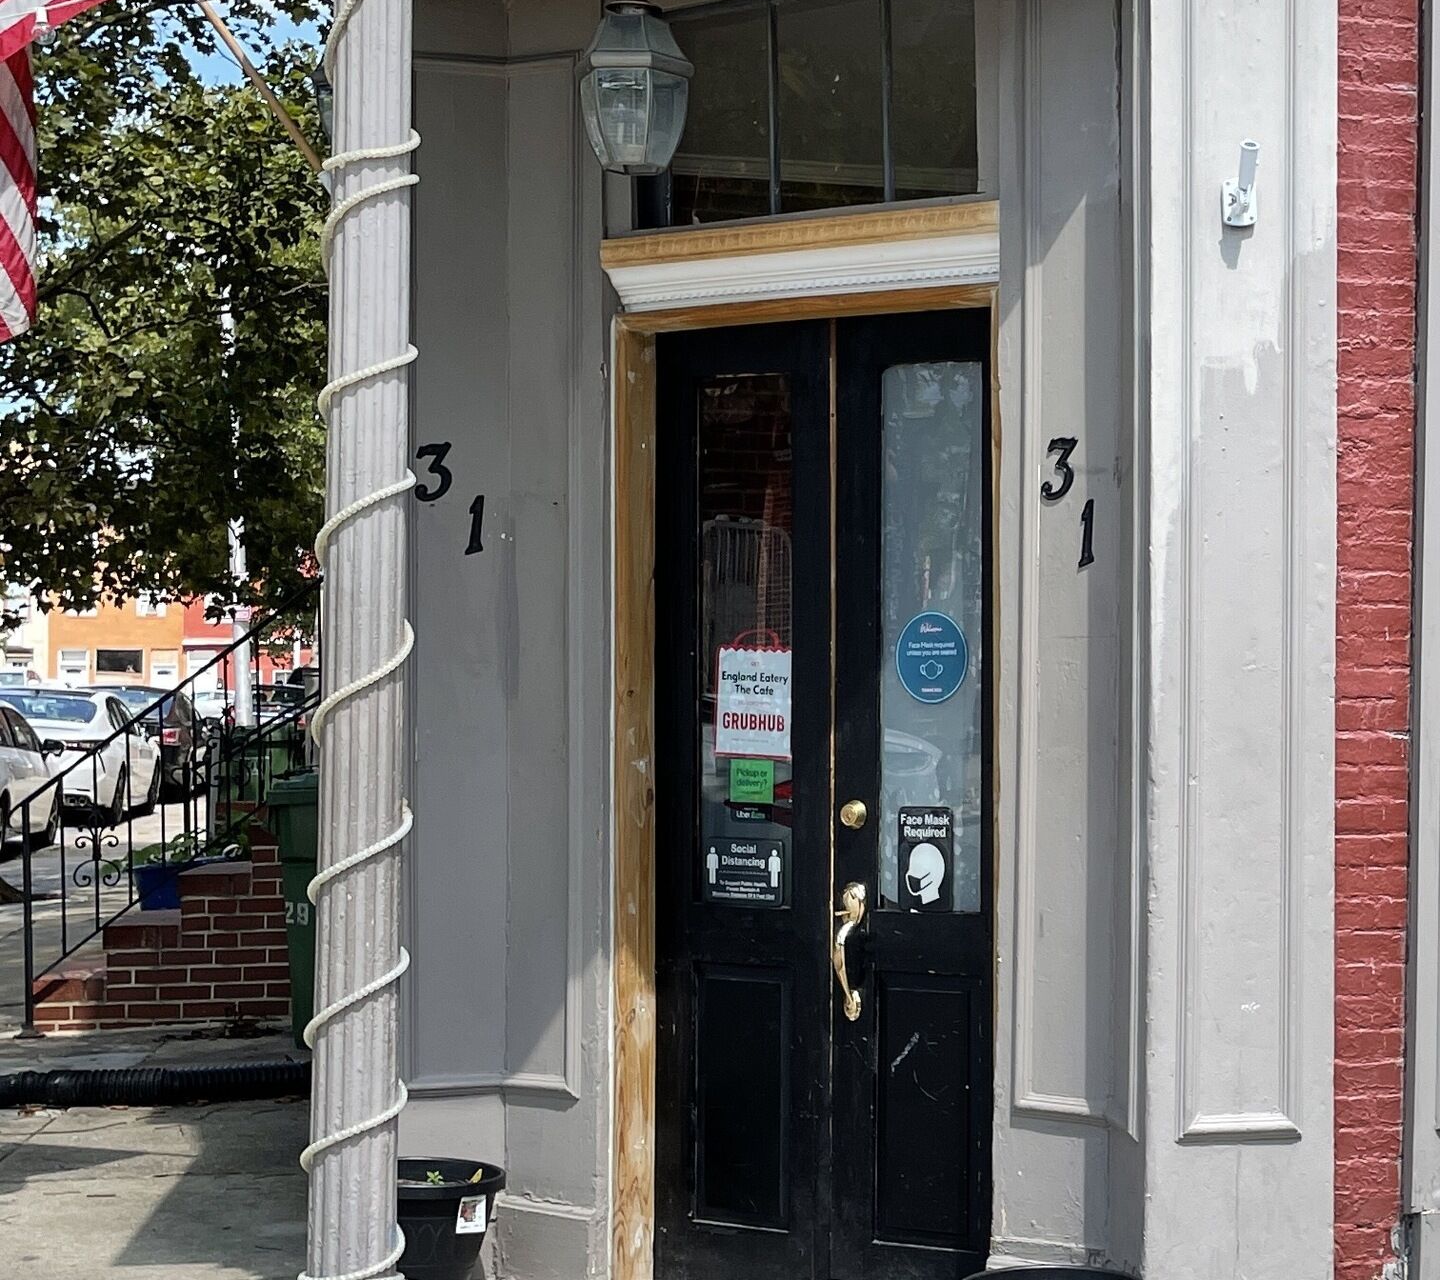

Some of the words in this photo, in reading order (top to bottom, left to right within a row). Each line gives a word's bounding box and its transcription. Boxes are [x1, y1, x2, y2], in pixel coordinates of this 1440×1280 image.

[721, 671, 758, 683] England
[759, 672, 789, 685] Eatery
[735, 684, 752, 695] The
[753, 685, 774, 696] Cafe
[722, 712, 785, 732] GRUBHUB
[900, 813, 923, 825] Face
[924, 813, 950, 826] Mask
[903, 826, 947, 839] Required
[730, 843, 757, 854] Social
[721, 855, 766, 869] Distancing
